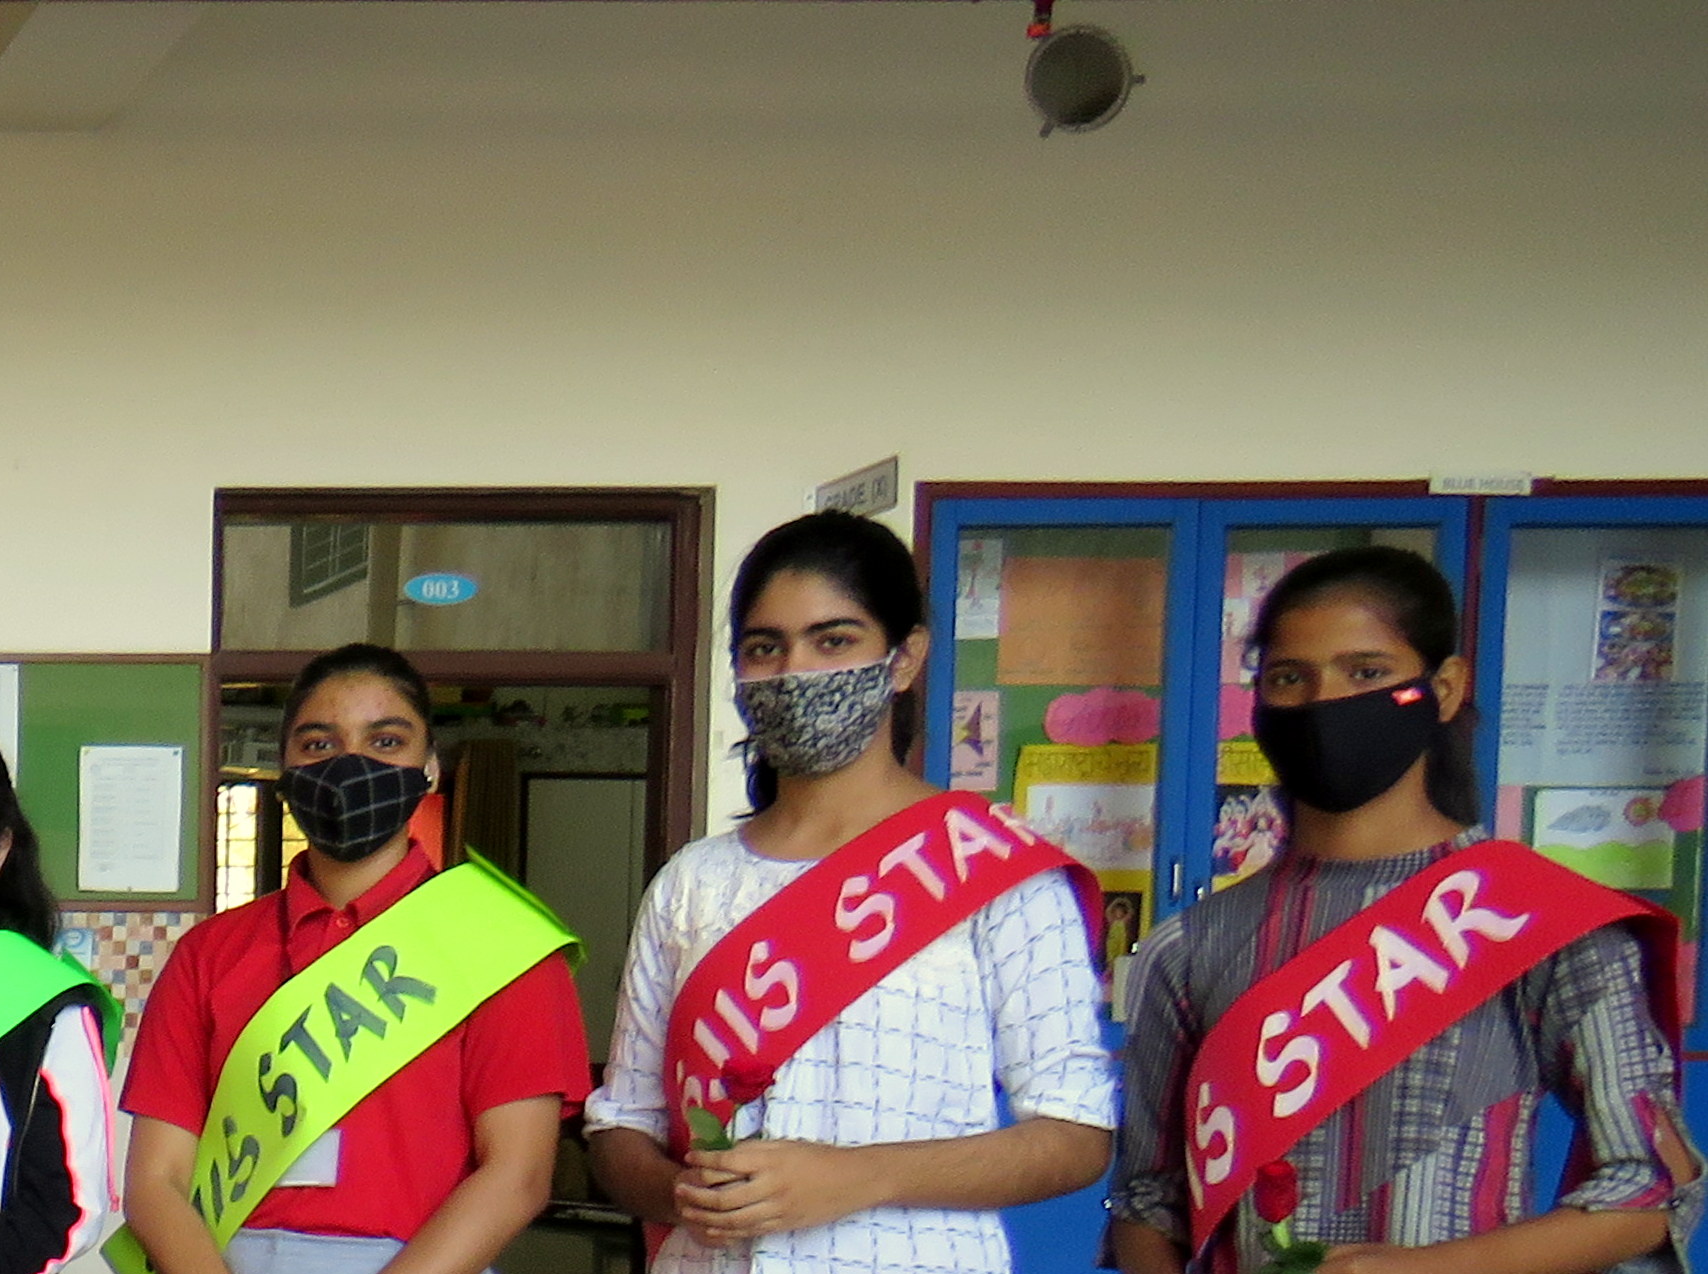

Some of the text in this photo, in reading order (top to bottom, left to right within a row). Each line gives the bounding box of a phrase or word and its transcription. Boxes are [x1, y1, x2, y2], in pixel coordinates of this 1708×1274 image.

[422, 579, 460, 600] 003
[258, 944, 437, 1138] STAR
[1255, 869, 1530, 1118] STAR
